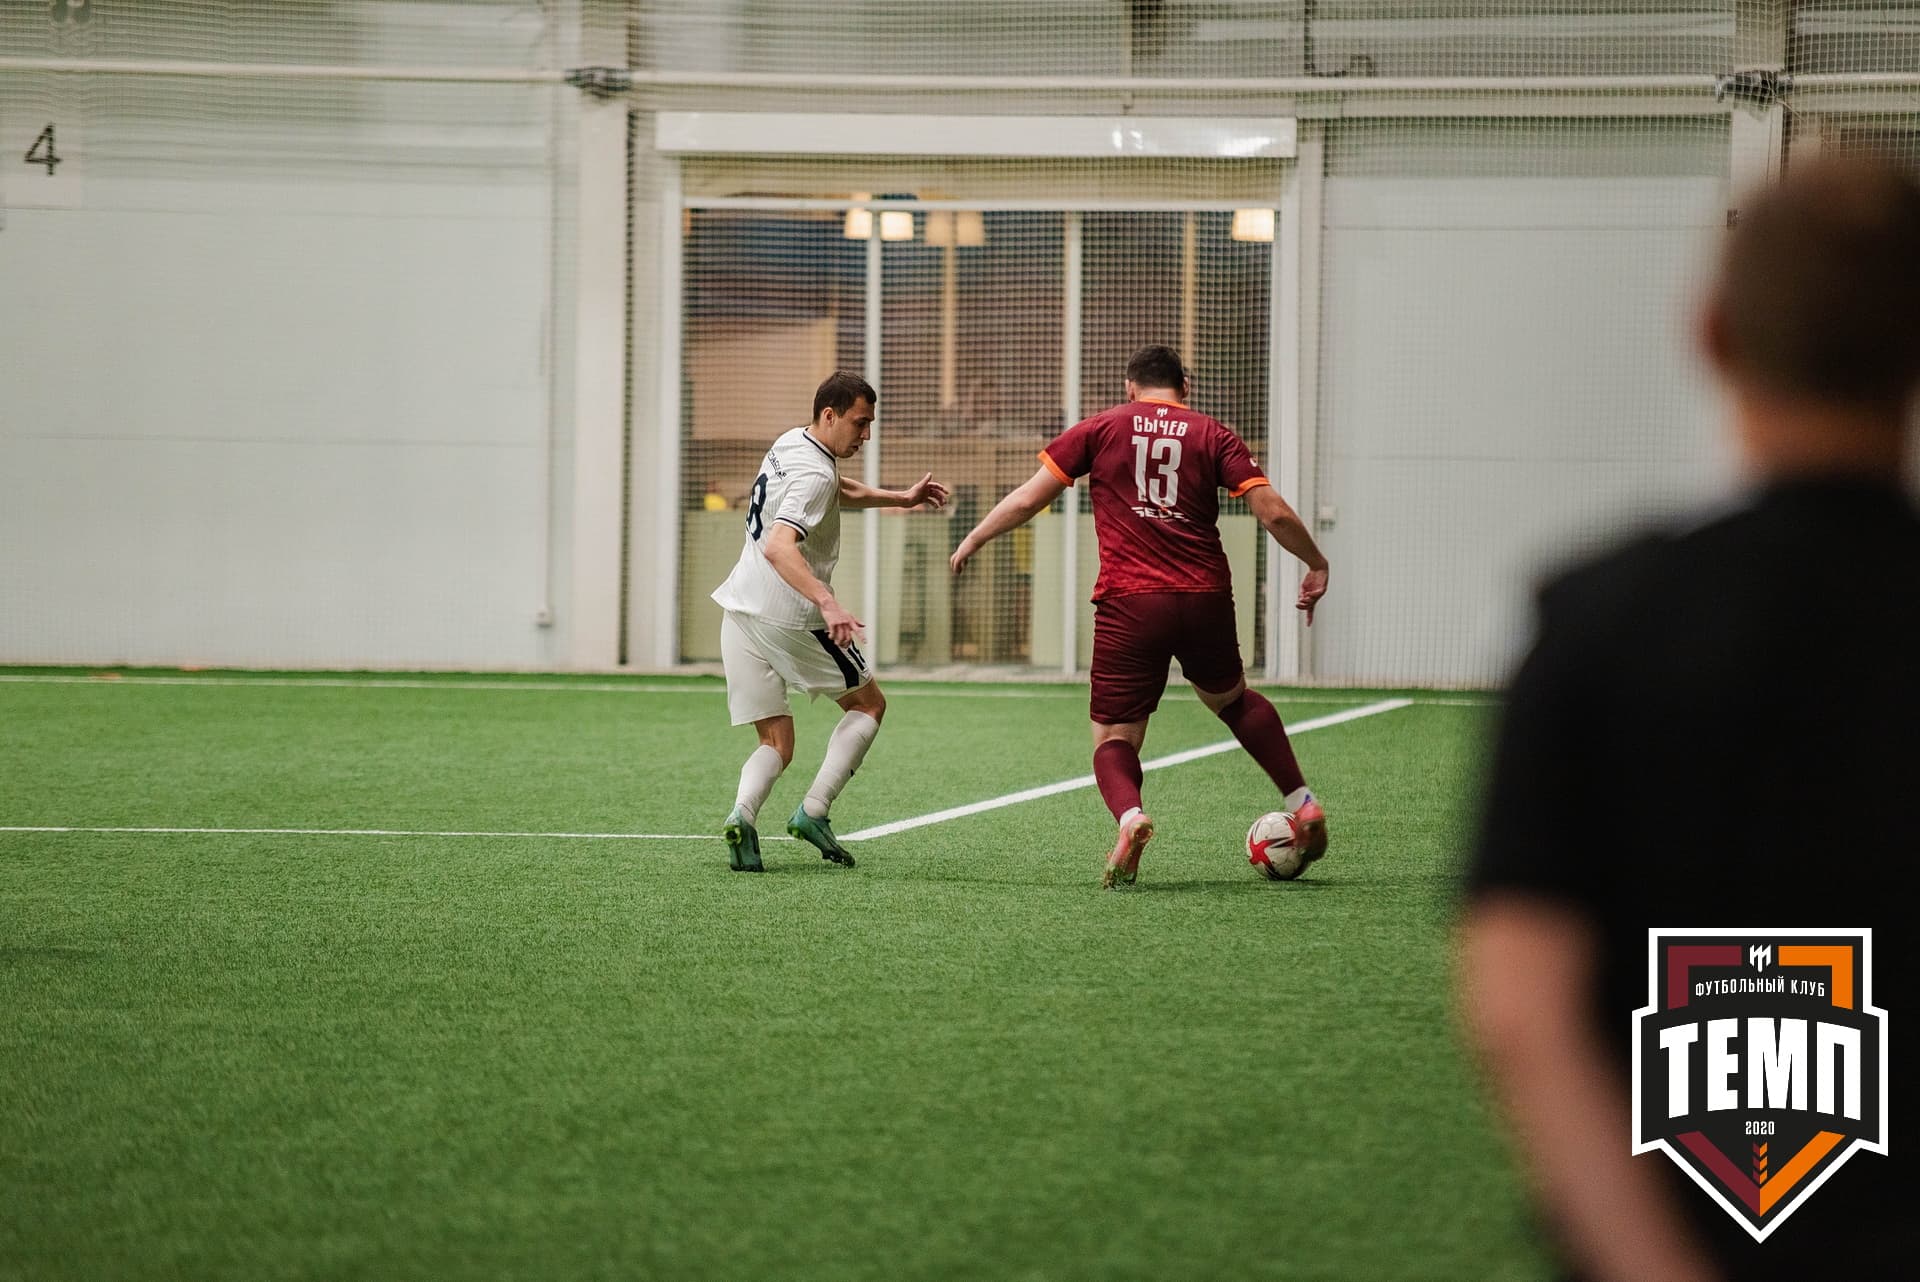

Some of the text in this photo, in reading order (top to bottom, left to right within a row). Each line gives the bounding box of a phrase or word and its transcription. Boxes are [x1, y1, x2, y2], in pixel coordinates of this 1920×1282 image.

[24, 122, 62, 176] 4
[1133, 415, 1188, 437] СЫЧЕВ
[1131, 435, 1182, 507] 13
